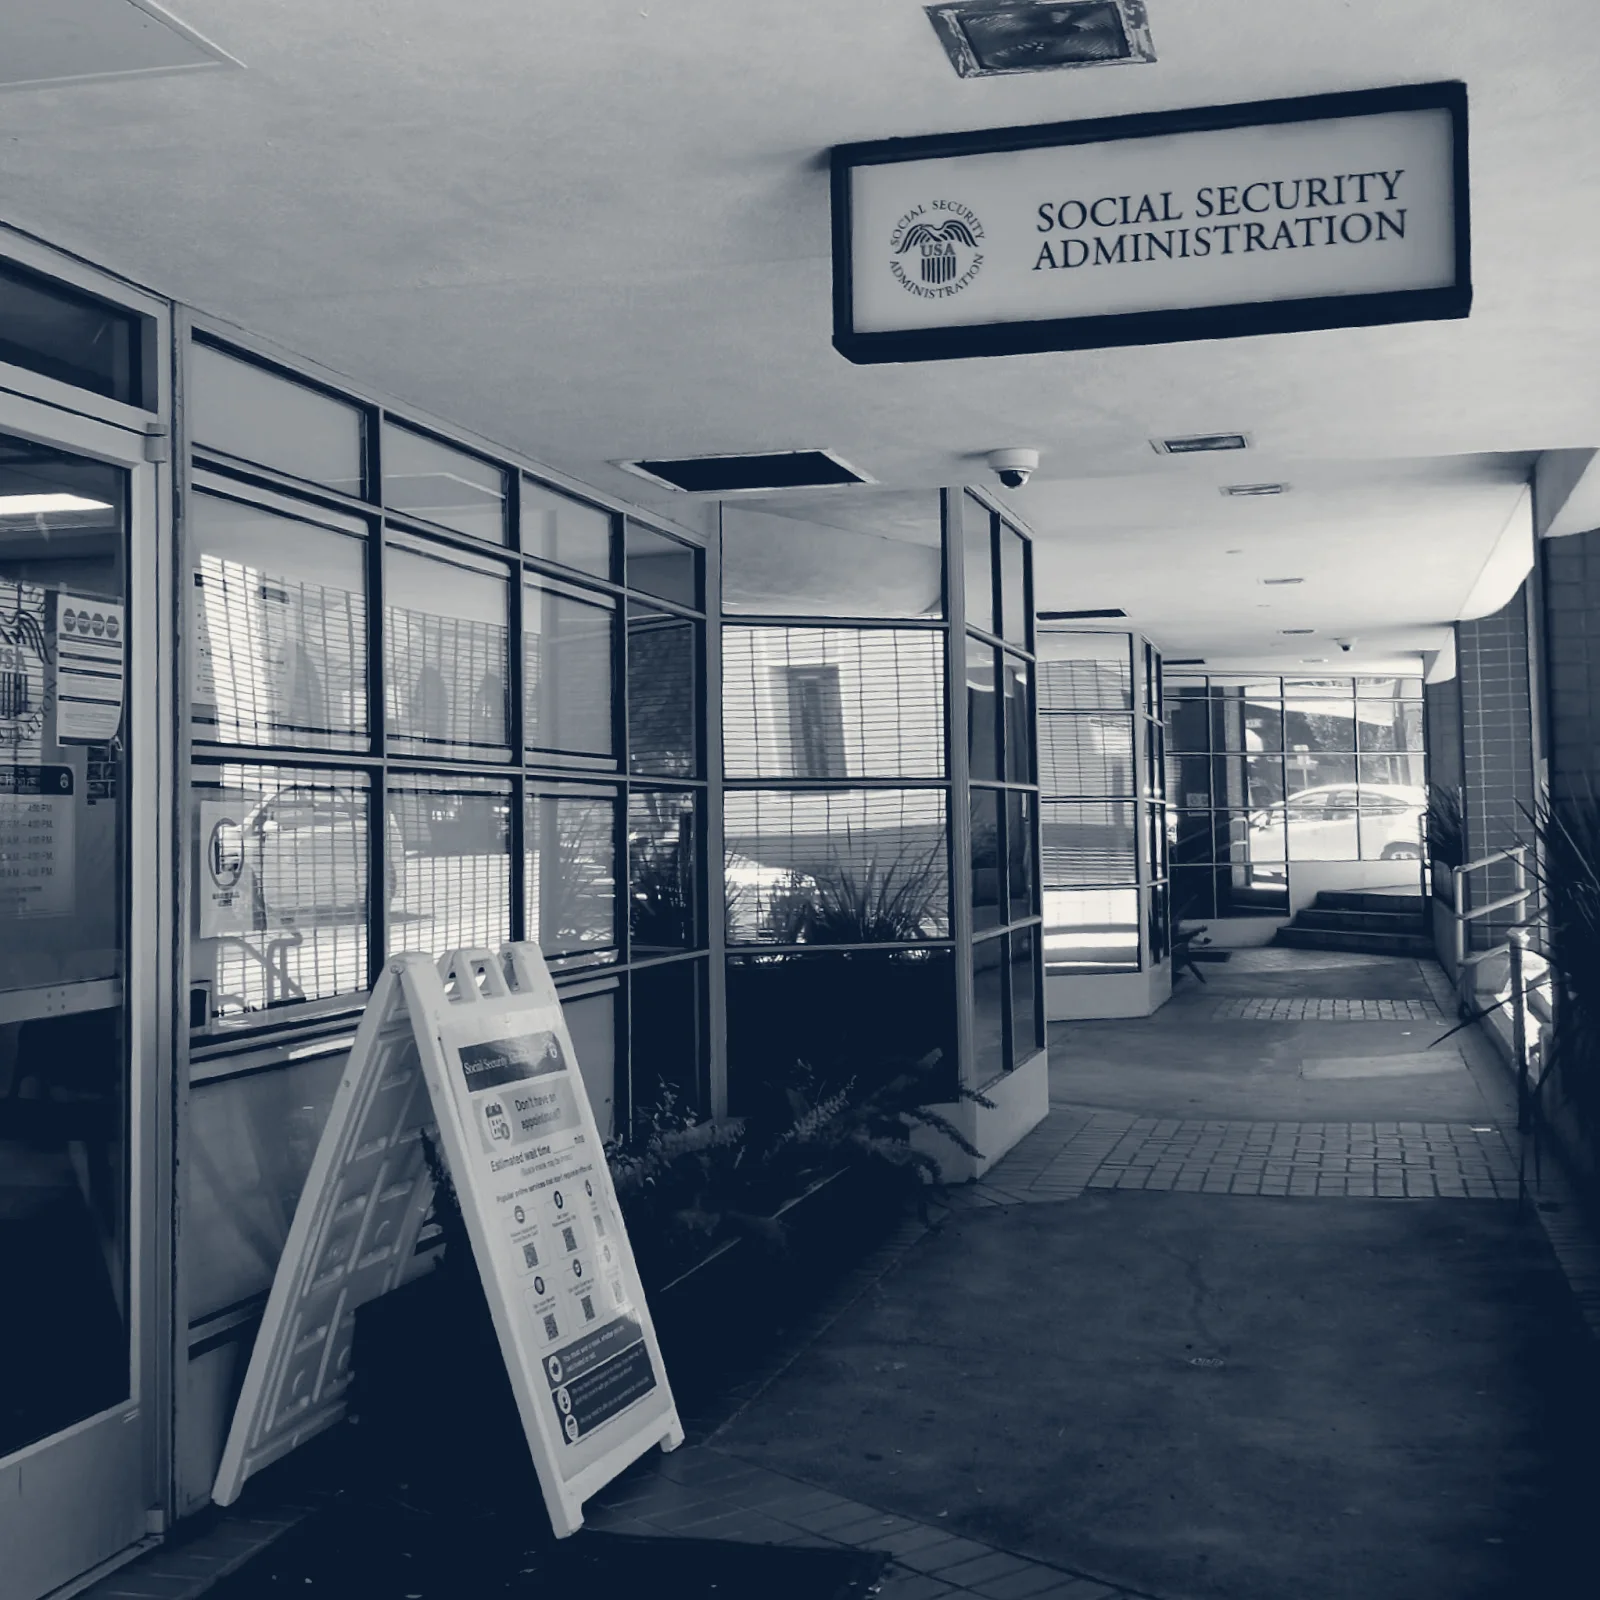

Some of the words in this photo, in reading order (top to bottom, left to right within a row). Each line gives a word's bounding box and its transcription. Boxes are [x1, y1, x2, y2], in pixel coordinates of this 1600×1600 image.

[890, 204, 926, 247] SOCIAL
[932, 200, 986, 240] SECURITY
[1036, 191, 1183, 233] SOCIAL
[1195, 170, 1405, 218] SECURITY
[920, 242, 956, 258] USA
[1032, 209, 1408, 270] ADMINISTRATION
[889, 253, 985, 299] ADMINISTRATION
[463, 1060, 483, 1075] Social
[491, 1152, 524, 1172] Estimated
